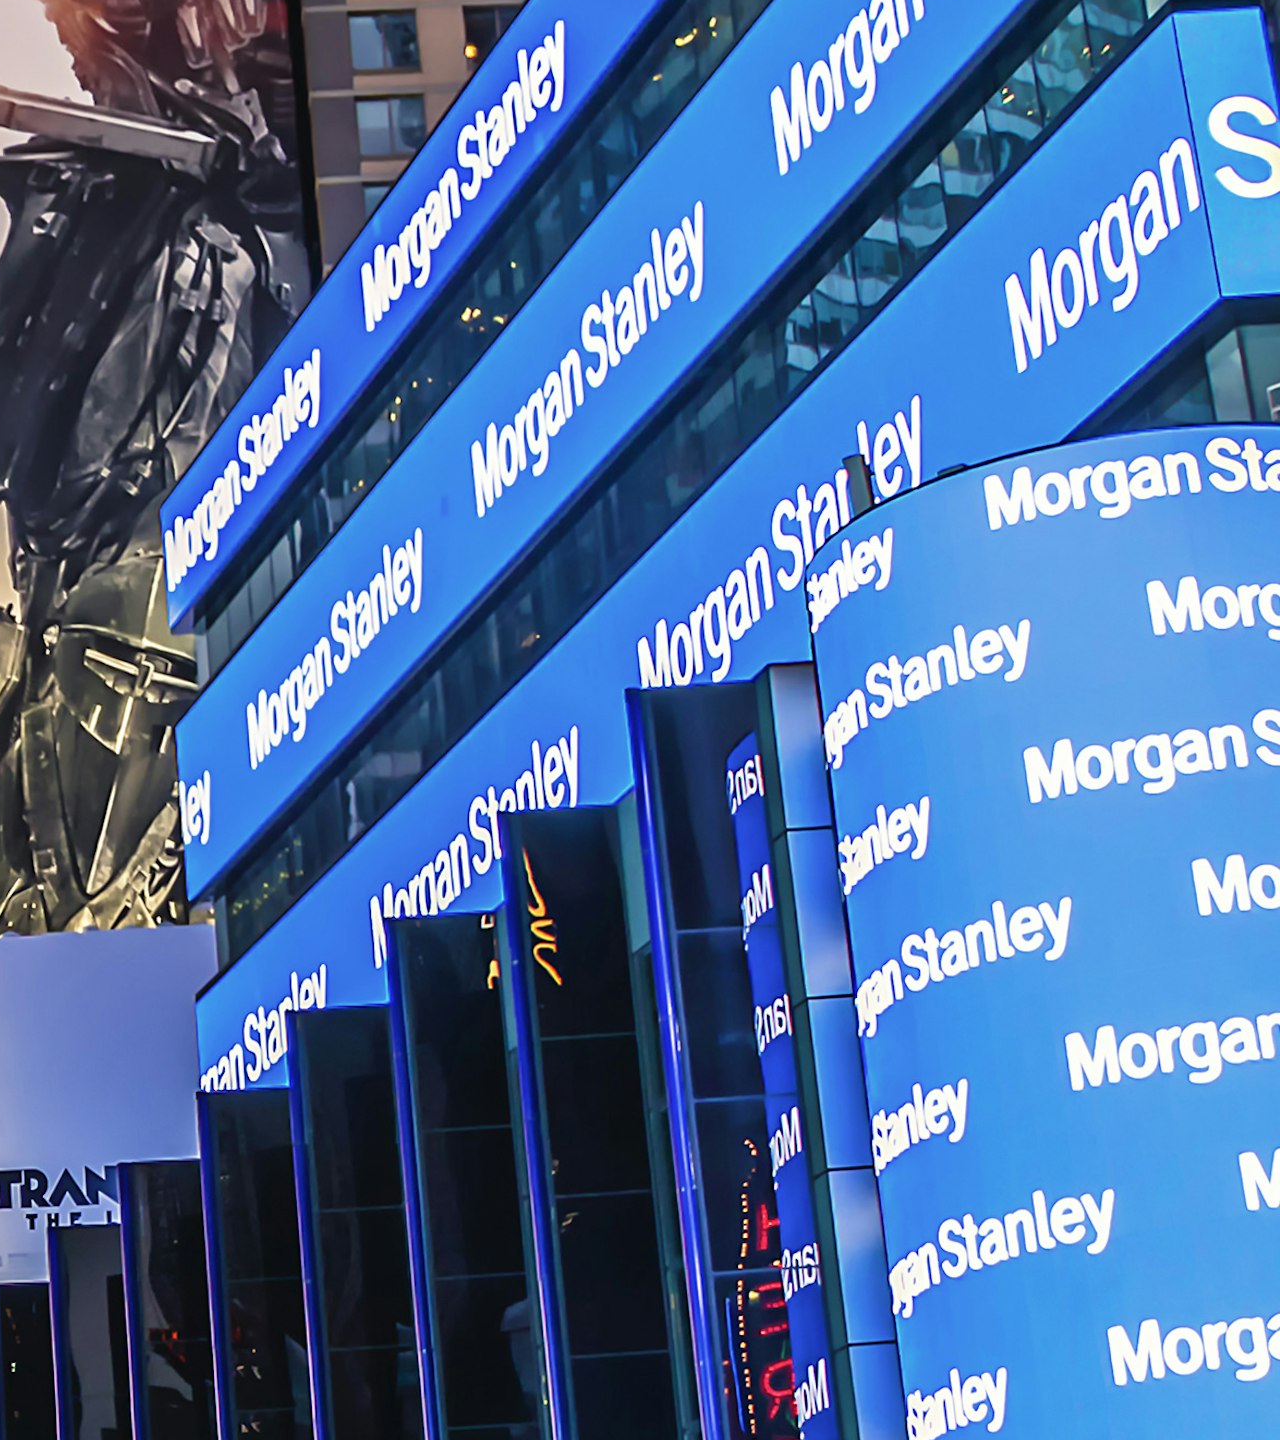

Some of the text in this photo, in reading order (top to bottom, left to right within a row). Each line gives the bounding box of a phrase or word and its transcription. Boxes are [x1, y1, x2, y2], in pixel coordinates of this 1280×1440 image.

[362, 21, 564, 332] Morgan Stanley
[1005, 138, 1199, 373] Morgan
[472, 201, 703, 517] Morgan Stanley
[165, 349, 320, 592] Morgan Stanley
[984, 452, 1202, 530] Morgan
[247, 528, 422, 769] Morgan Stanley
[638, 547, 773, 688] Morgan
[866, 619, 1030, 718] Stanley
[1024, 725, 1249, 803] Morgan
[902, 897, 1072, 991] Stanley
[872, 1079, 968, 1176] Stanley
[939, 1189, 1114, 1277] Stanley
